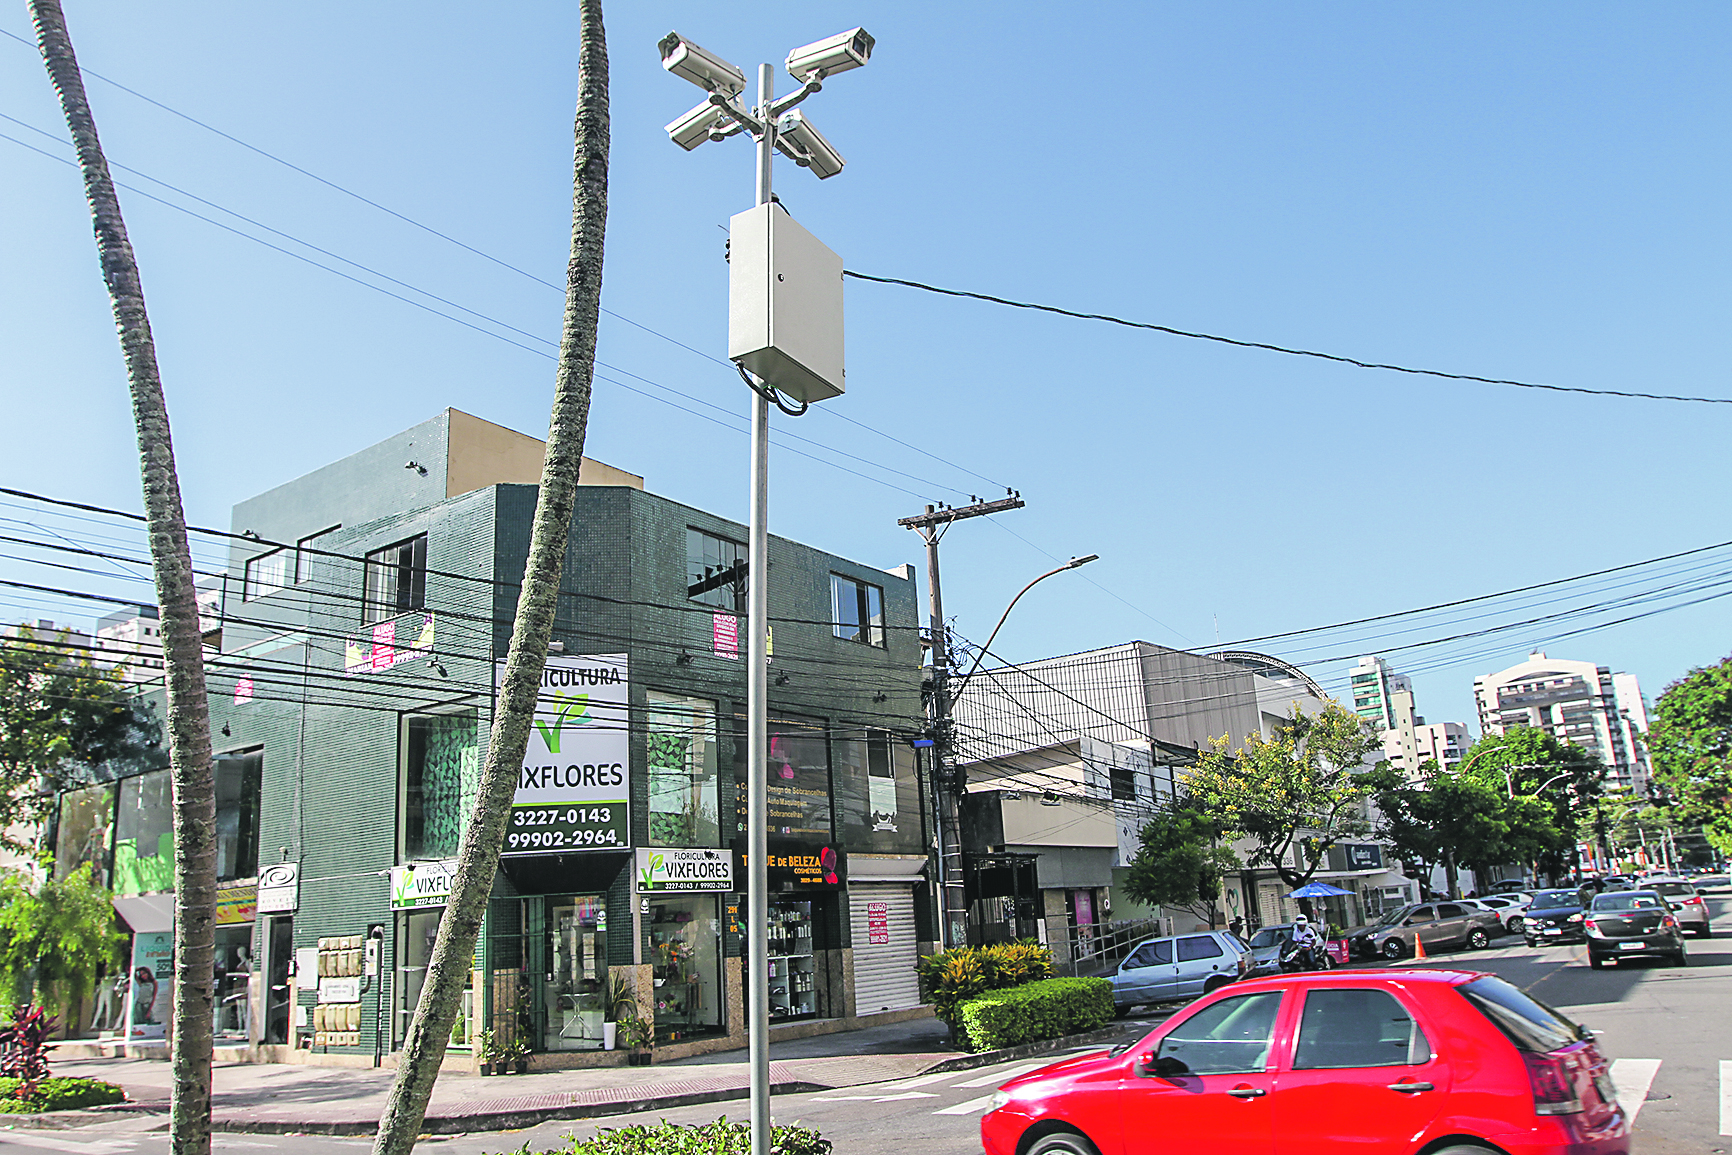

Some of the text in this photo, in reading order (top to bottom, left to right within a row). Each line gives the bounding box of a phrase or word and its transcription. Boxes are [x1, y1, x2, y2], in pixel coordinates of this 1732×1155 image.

[374, 622, 395, 635] ALUGO
[539, 667, 621, 687] ICULTURA
[513, 807, 611, 826] 3227-0143
[508, 829, 617, 848] 99902-2964
[788, 855, 821, 867] BELEZA
[665, 862, 729, 878] VIXFLORES
[665, 882, 693, 890] 3227-0143
[415, 896, 443, 906] 3227-0143
